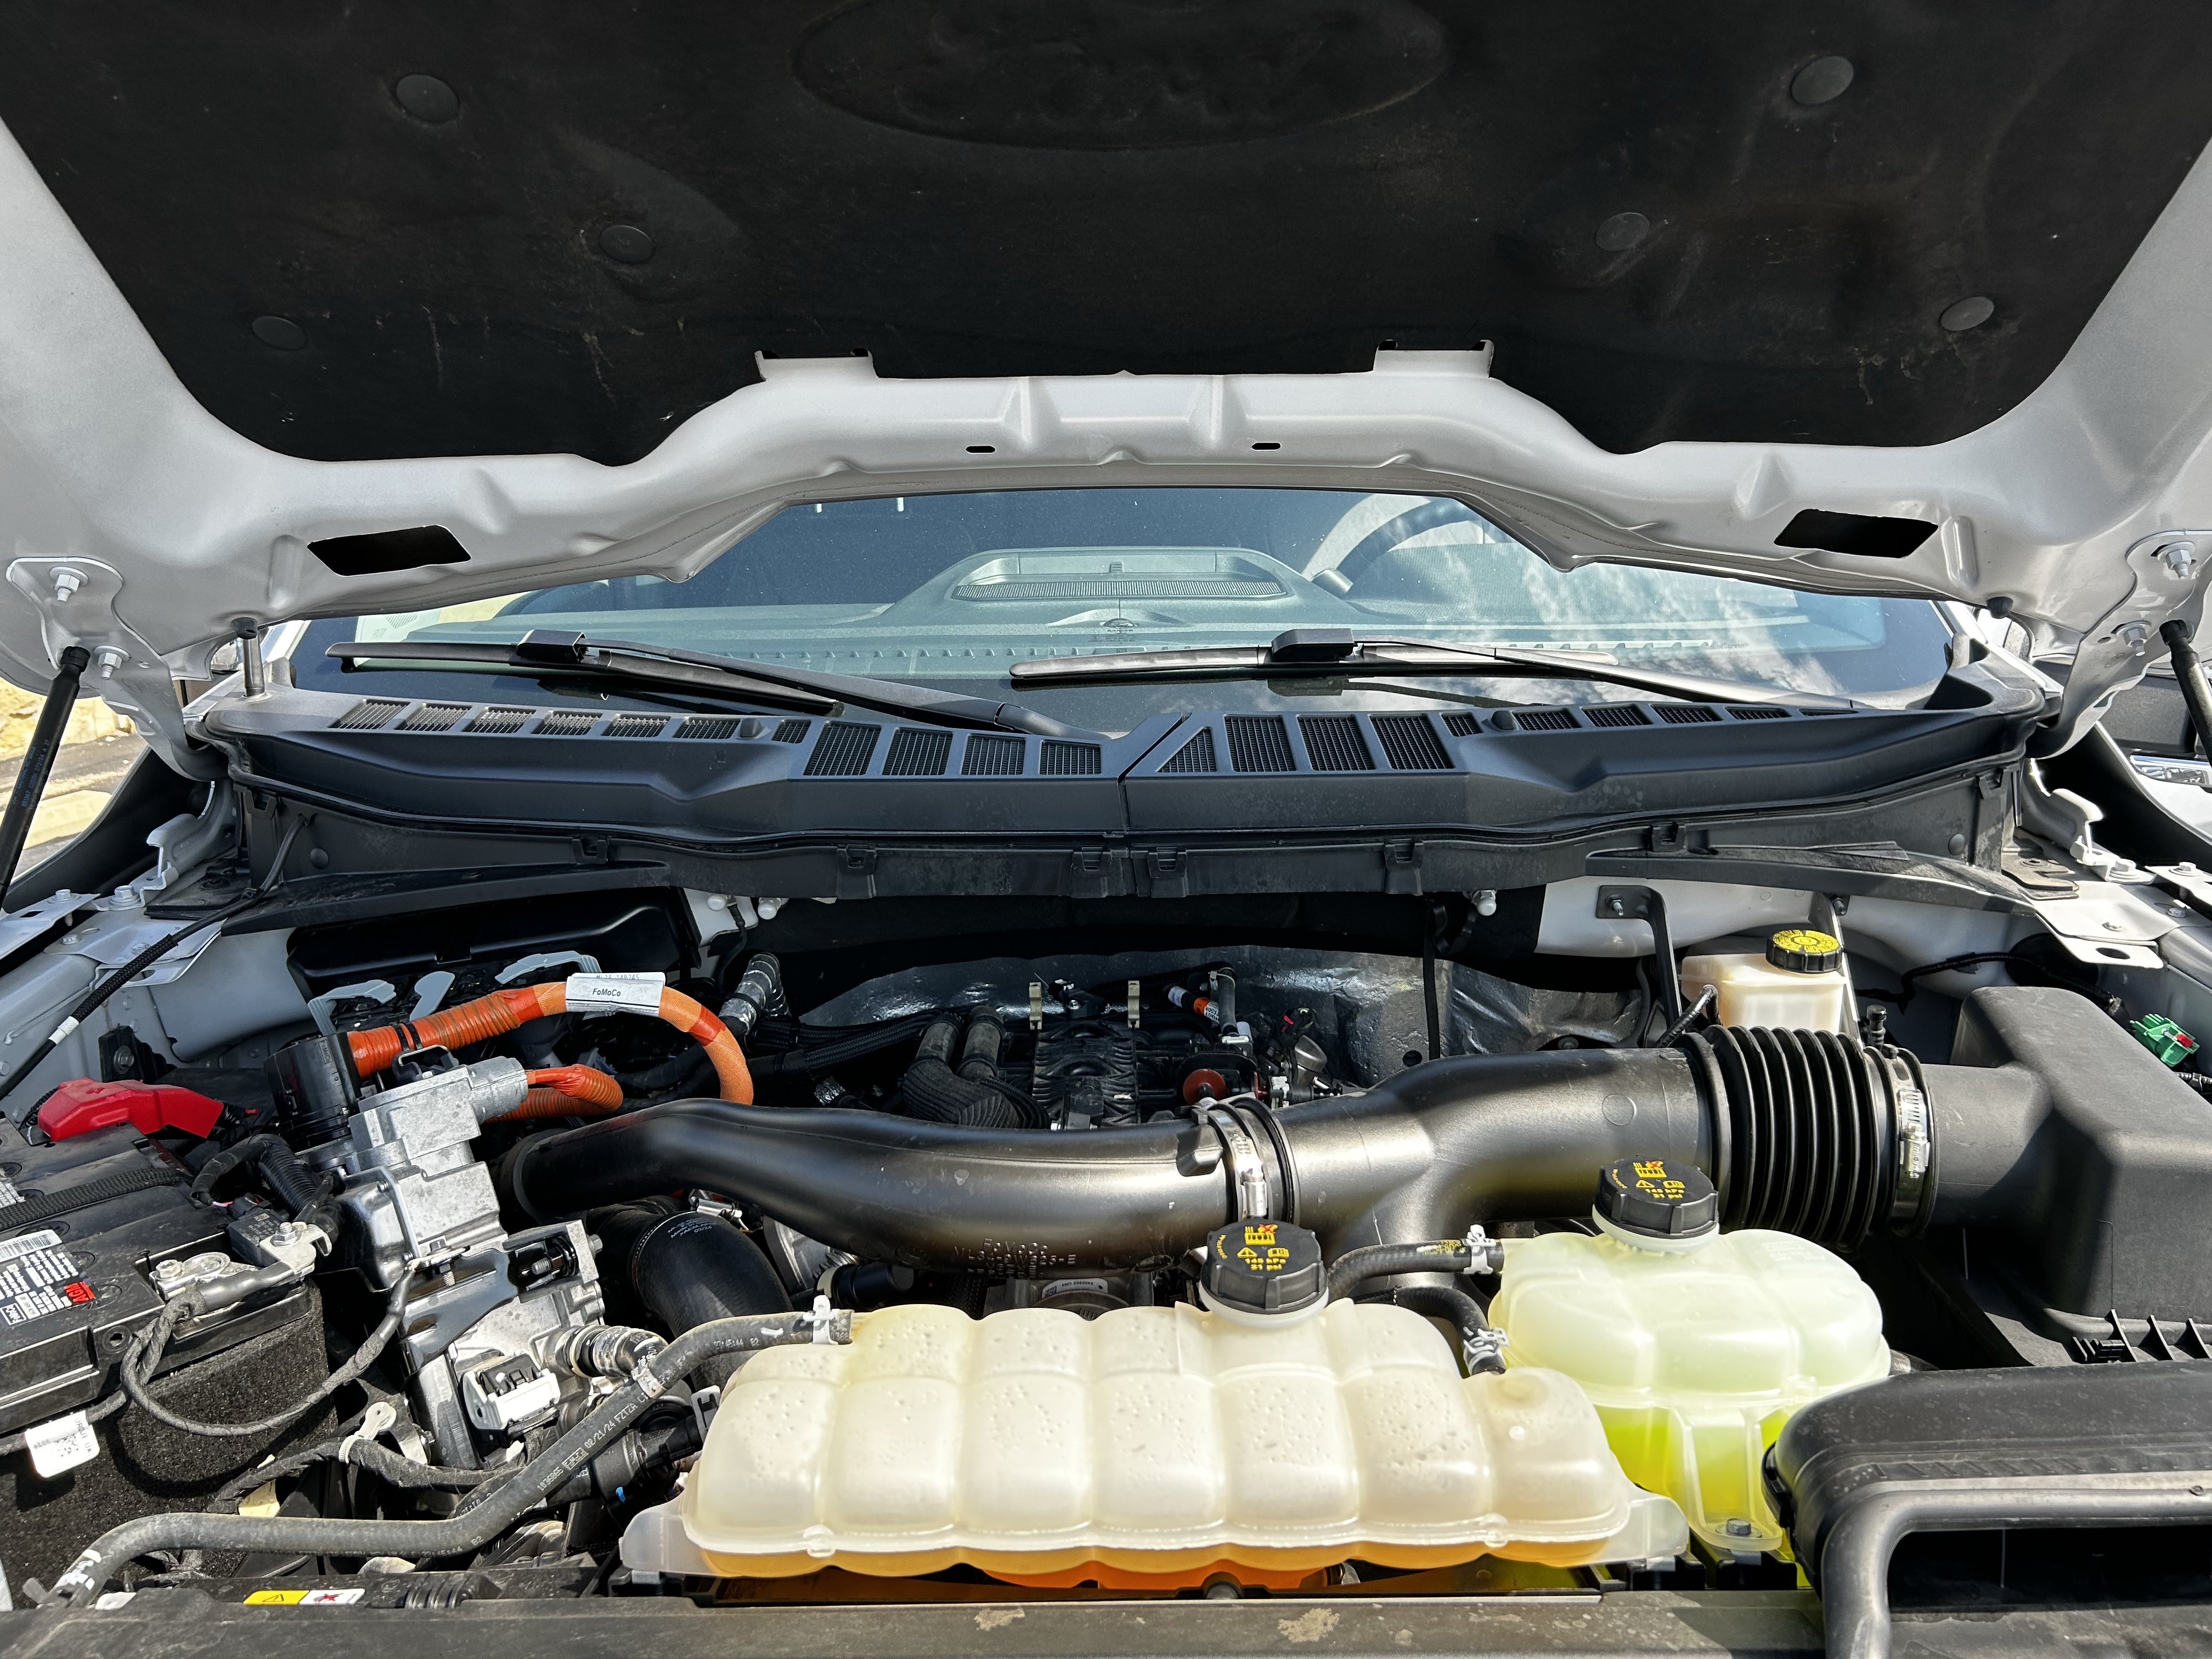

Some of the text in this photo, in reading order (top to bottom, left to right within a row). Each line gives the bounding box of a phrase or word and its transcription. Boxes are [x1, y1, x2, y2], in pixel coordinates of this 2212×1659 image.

[592, 988, 621, 996] FoMoCo
[320, 1040, 330, 1063] FoMoCo
[983, 1238, 1048, 1255] FoMoCo
[64, 1283, 89, 1303] AGM
[584, 1422, 616, 1448] 02/21/24
[470, 1536, 484, 1546] B2
